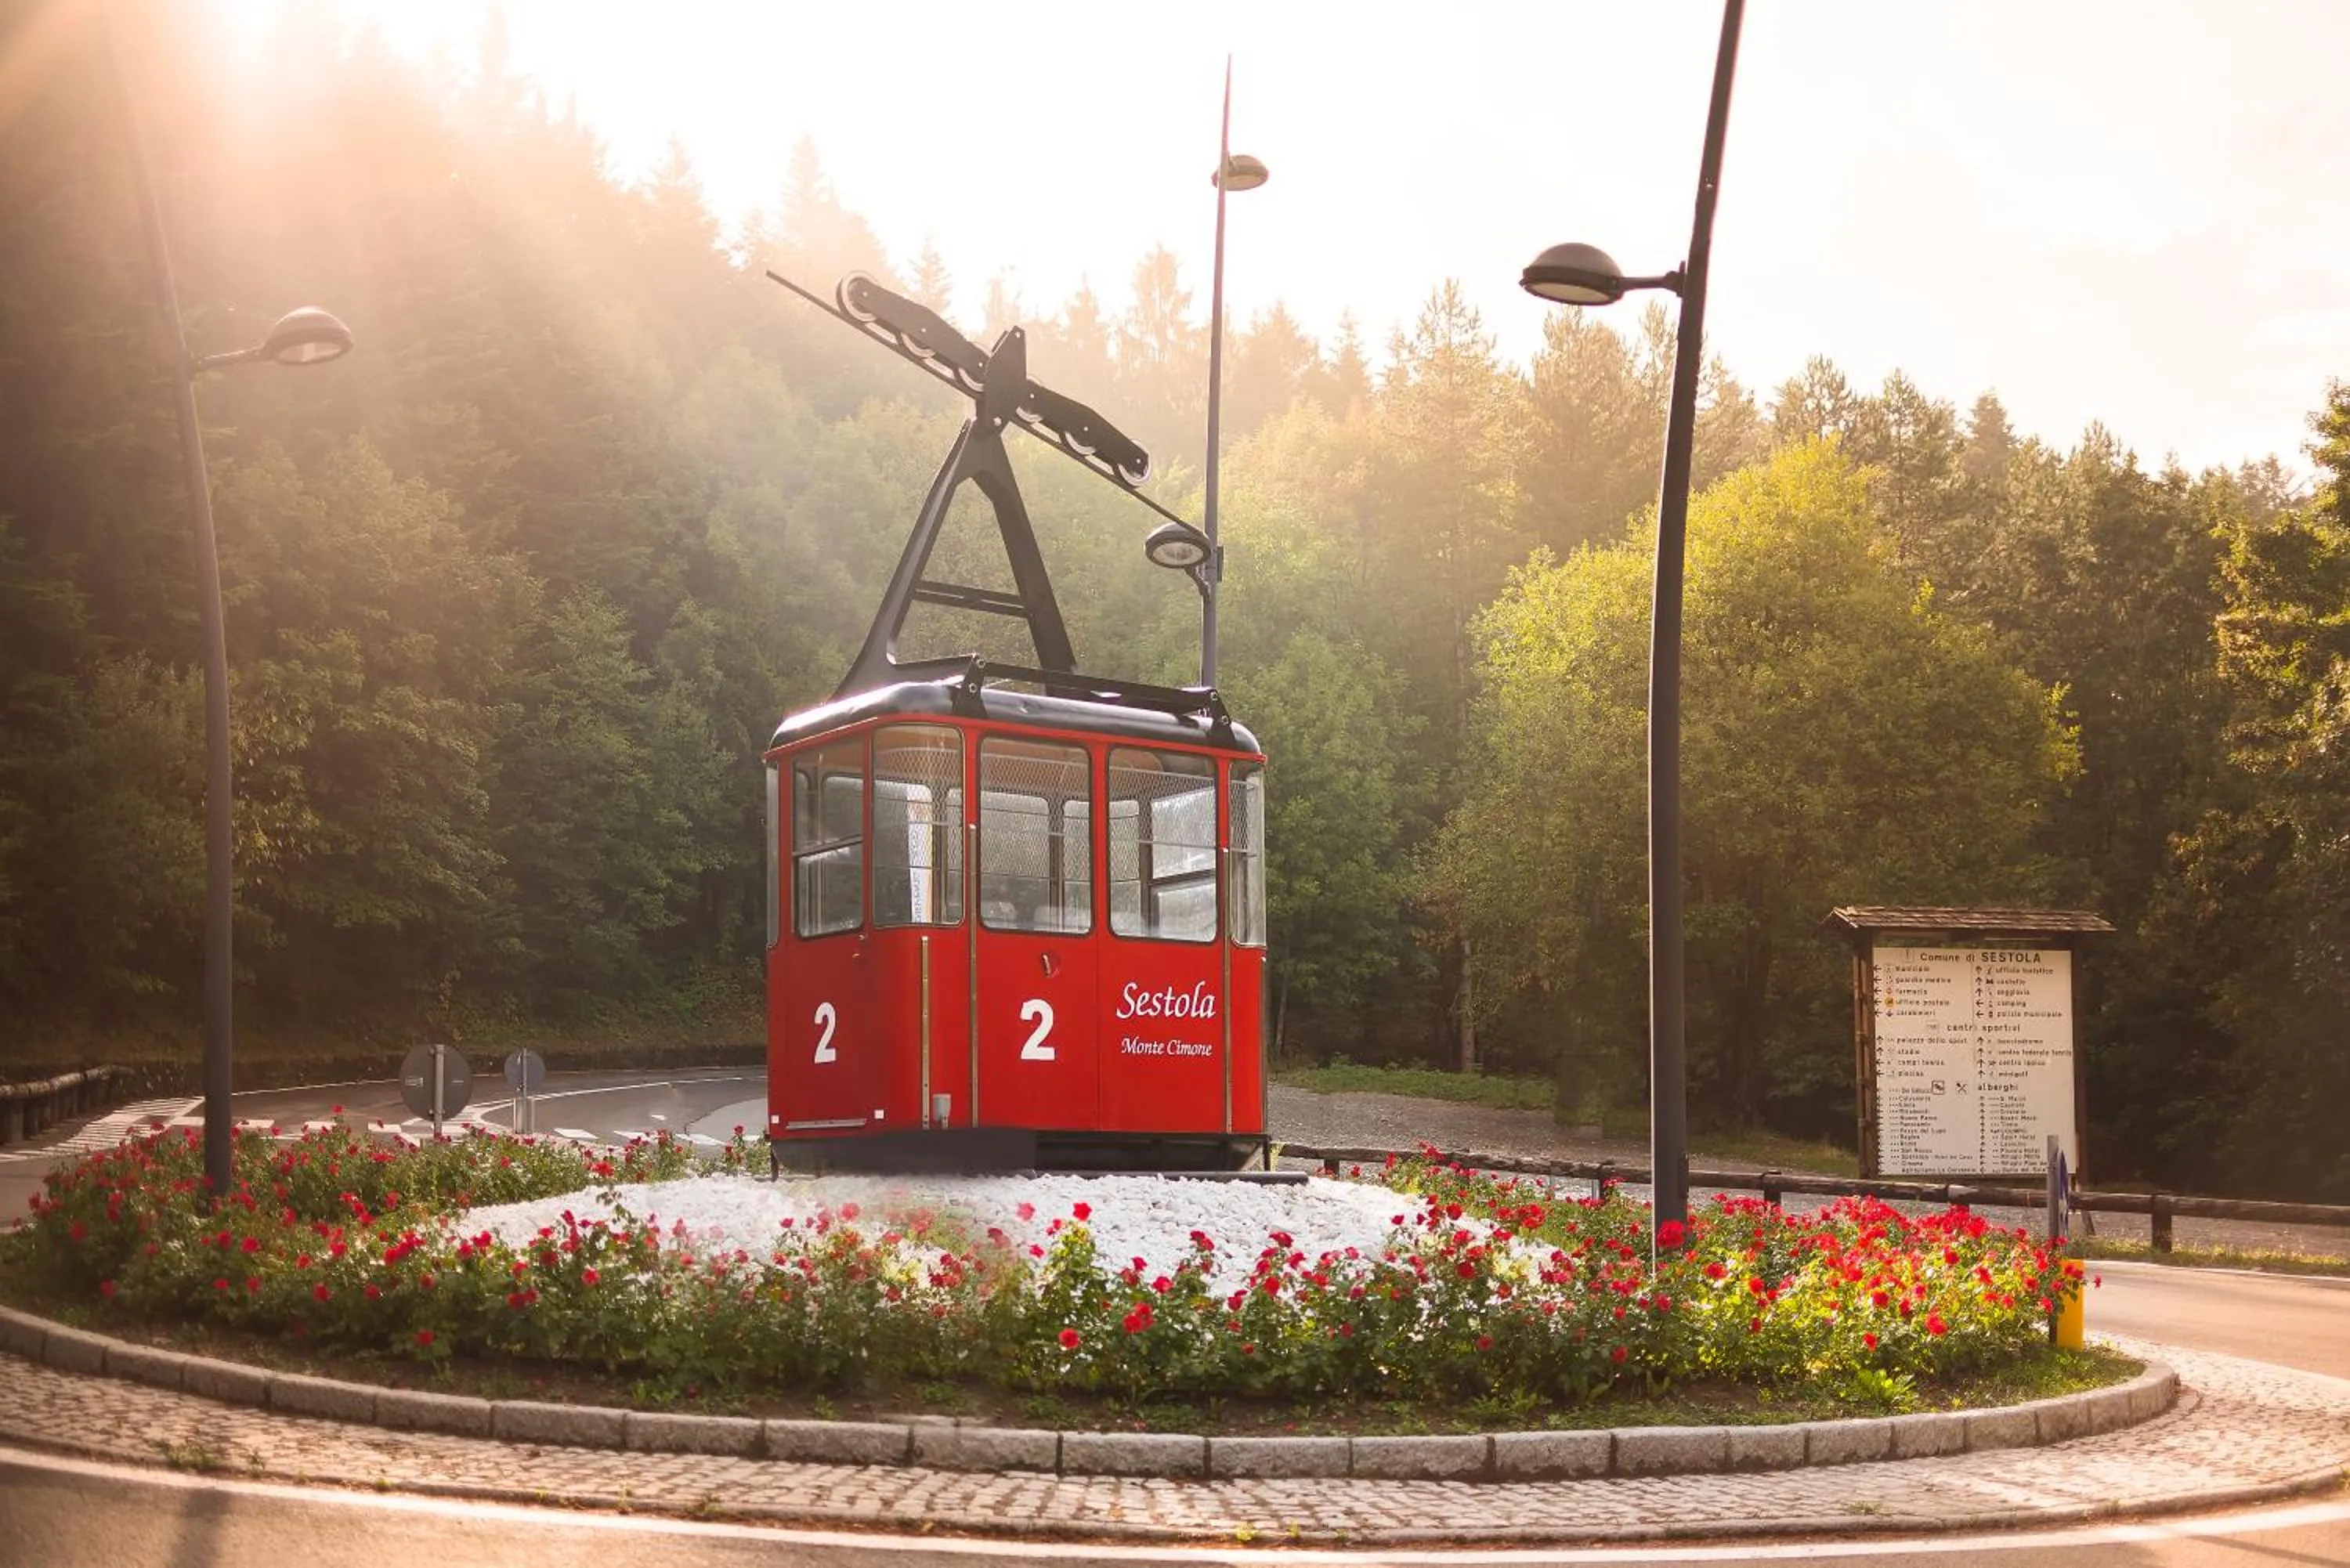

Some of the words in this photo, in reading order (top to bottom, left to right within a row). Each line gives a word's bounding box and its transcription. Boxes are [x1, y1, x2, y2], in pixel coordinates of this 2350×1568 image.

[1920, 952, 1960, 962] Comune
[1965, 953, 1975, 963] di
[1981, 952, 2041, 963] SESTOLA
[1116, 981, 1216, 1018] Sestola
[815, 1003, 836, 1063] 2
[1021, 999, 1054, 1060] 2
[1122, 1036, 1164, 1054] Monte
[1167, 1040, 1212, 1056] Cimone
